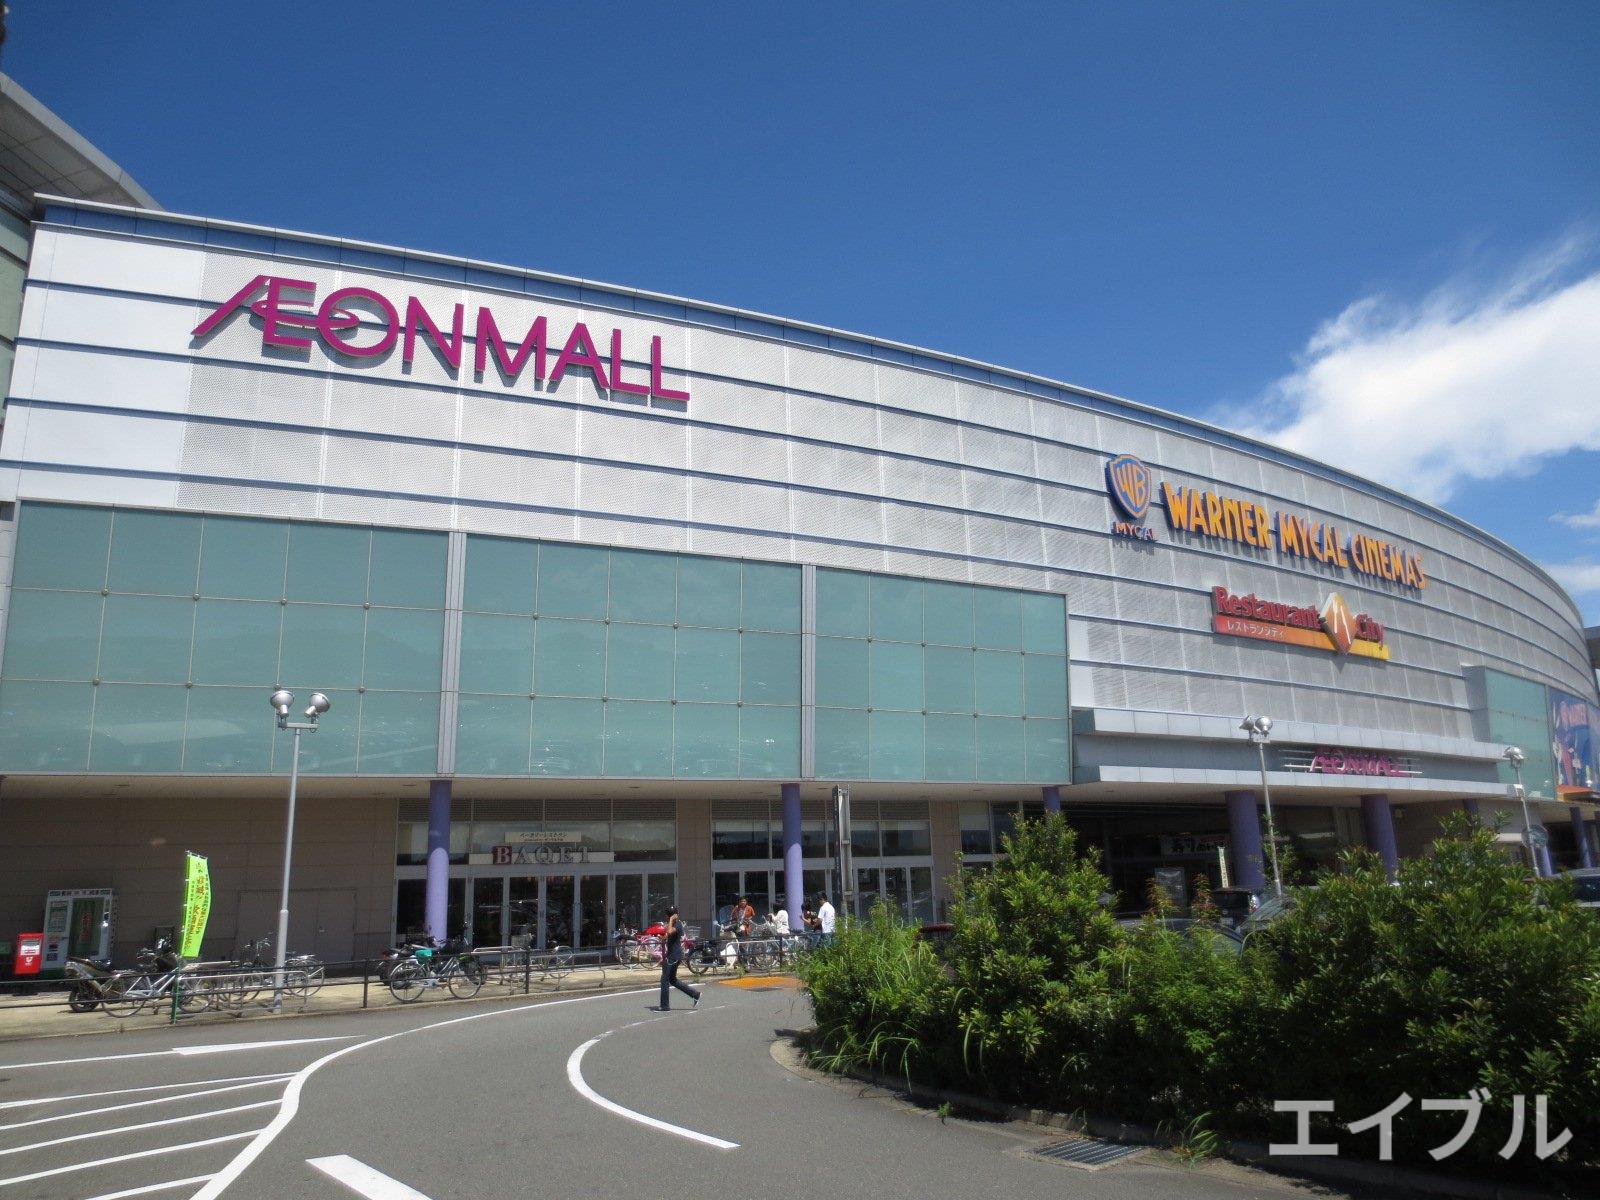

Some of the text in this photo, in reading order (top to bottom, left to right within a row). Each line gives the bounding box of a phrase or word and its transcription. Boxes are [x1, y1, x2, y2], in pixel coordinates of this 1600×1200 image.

[1160, 481, 1426, 590] WARNER MYCAL CINEMAS
[1213, 586, 1322, 631] Restaurant
[494, 845, 592, 864] BAQET
